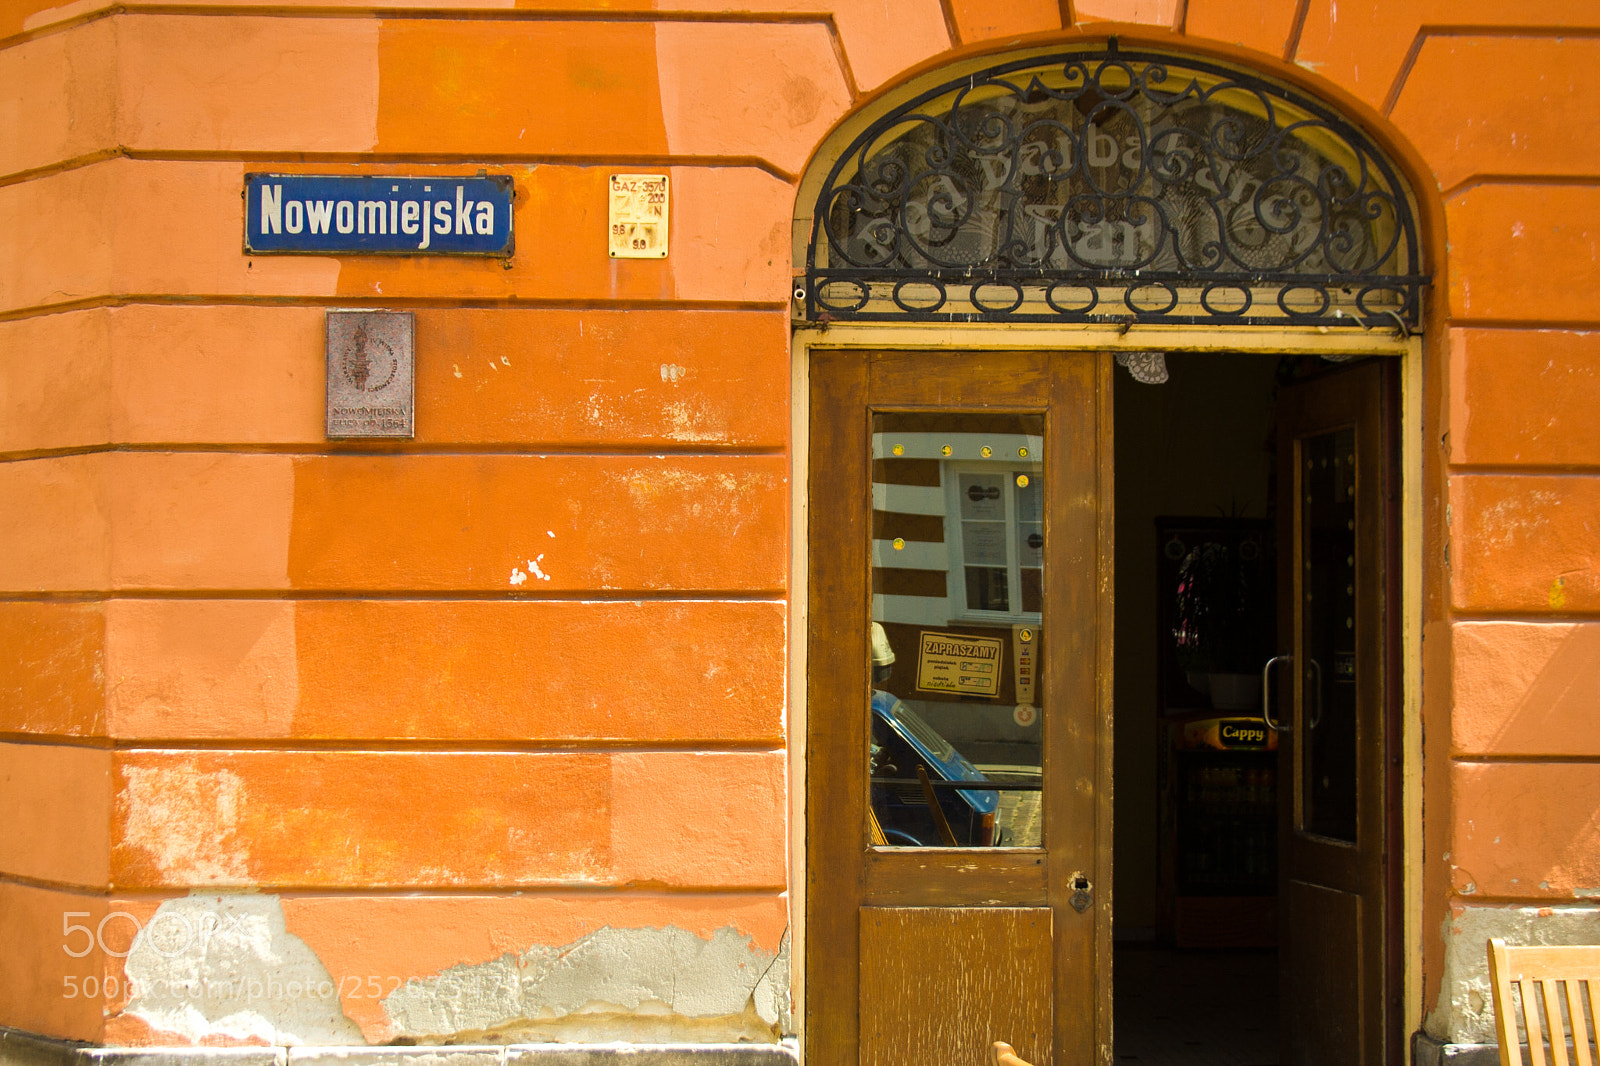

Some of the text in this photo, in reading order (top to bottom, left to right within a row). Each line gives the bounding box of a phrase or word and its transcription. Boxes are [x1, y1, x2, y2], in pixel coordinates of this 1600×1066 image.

[647, 193, 666, 204] 200
[261, 184, 494, 249] Nowomiejska
[654, 205, 662, 217] N
[333, 406, 406, 416] NOWOMIEJSKA
[381, 418, 406, 428] 1564
[925, 641, 997, 660] ZAPRASZAMY
[1222, 725, 1264, 741] Cappy
